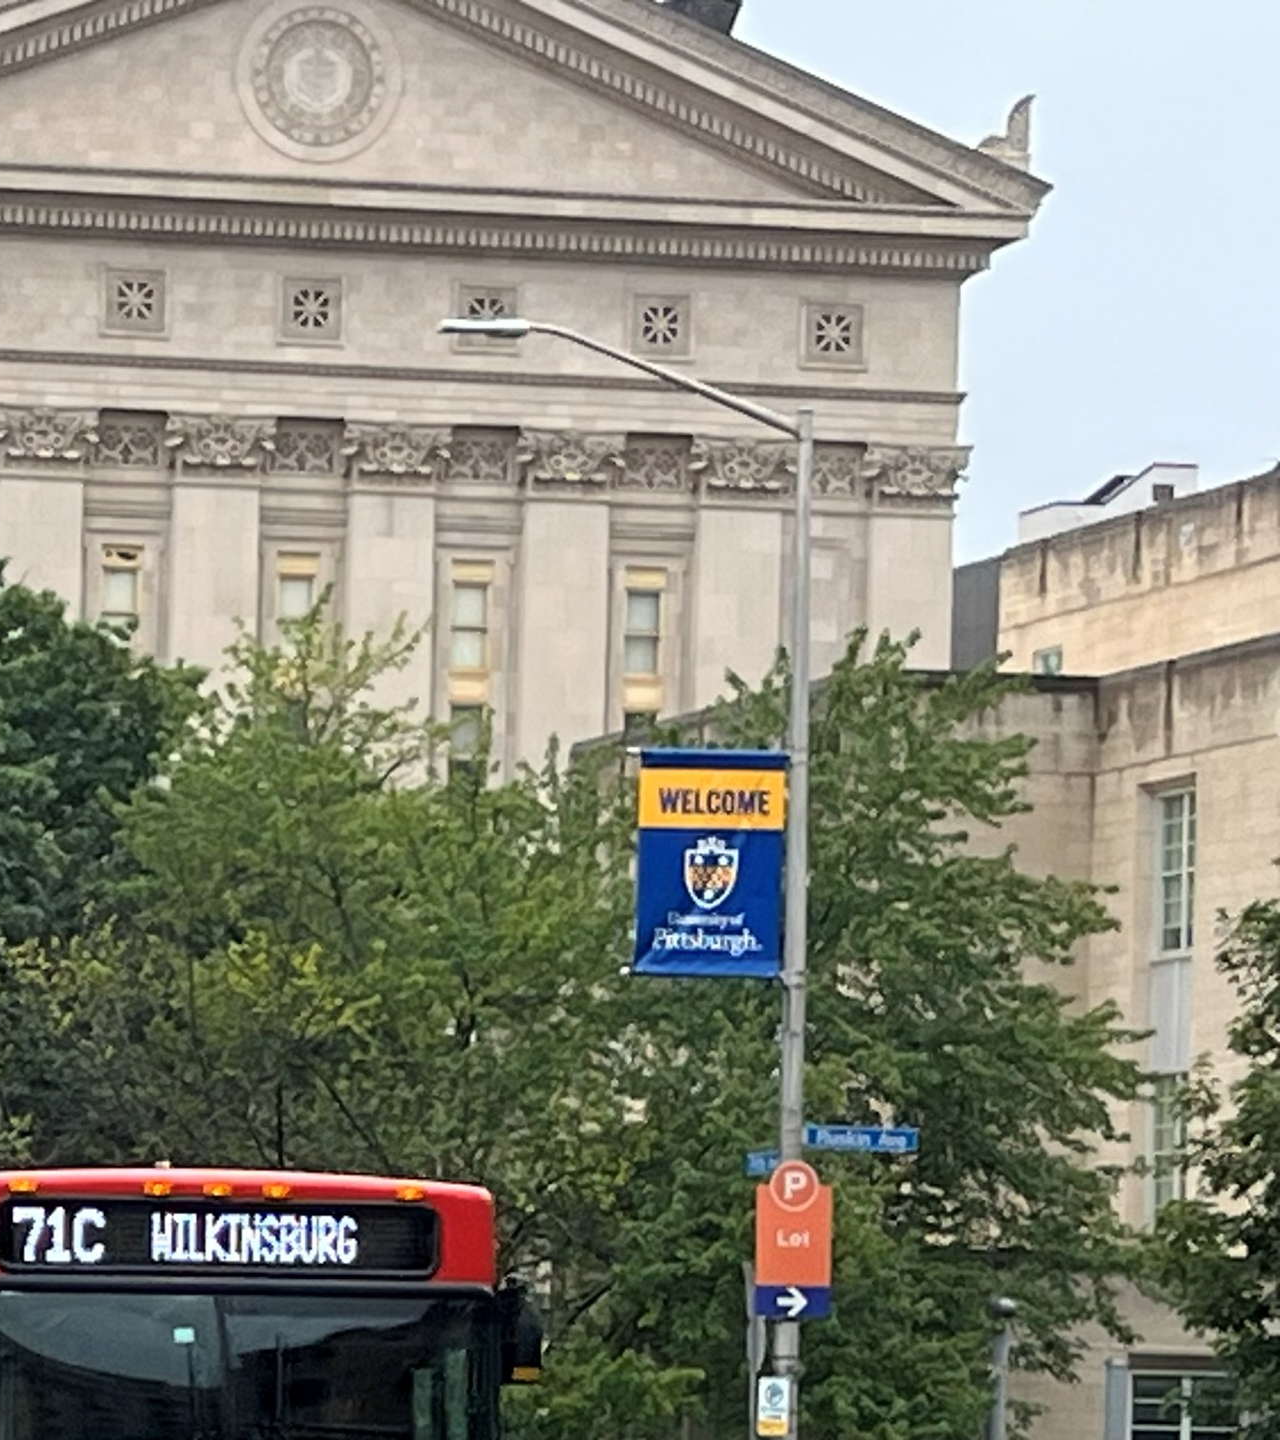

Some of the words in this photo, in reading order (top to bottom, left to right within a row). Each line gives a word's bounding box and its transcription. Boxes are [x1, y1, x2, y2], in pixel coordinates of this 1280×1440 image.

[658, 788, 771, 816] WELCOME
[783, 1171, 807, 1200] P
[12, 1206, 107, 1264] 71C
[151, 1211, 359, 1264] WILKINSBURG
[776, 1228, 810, 1248] Lot
